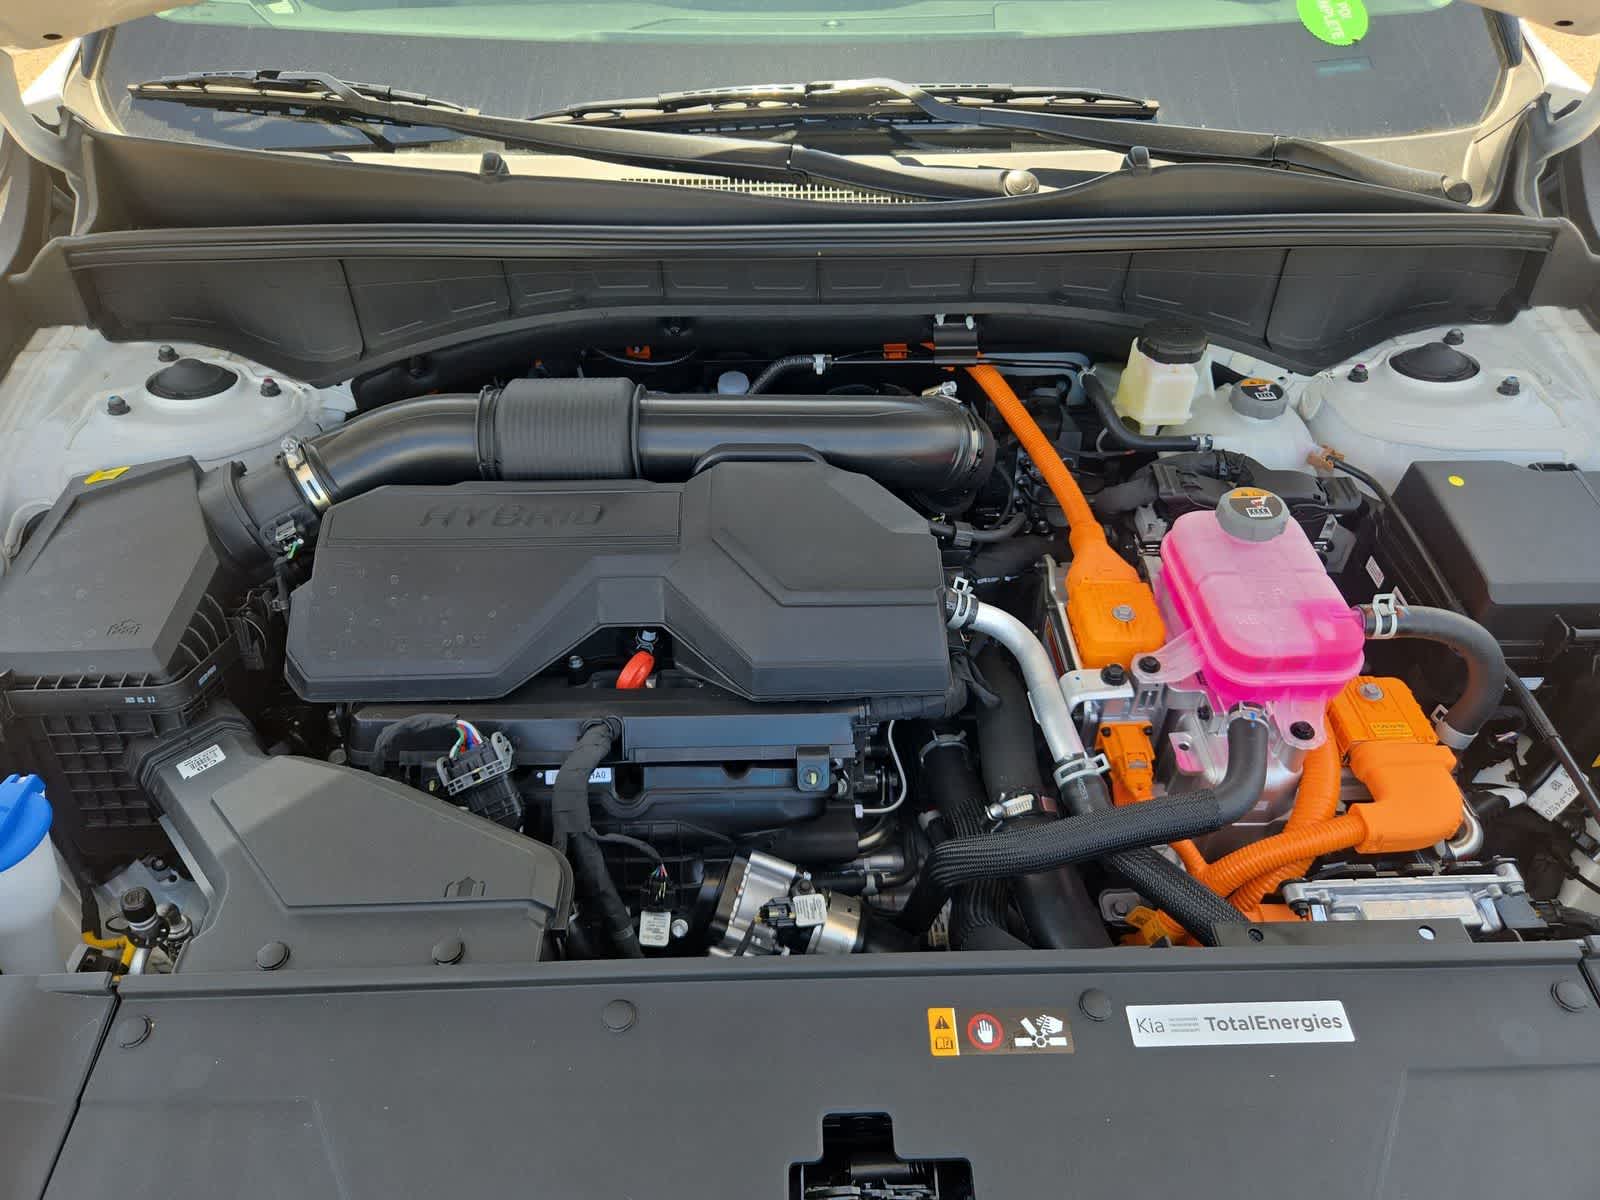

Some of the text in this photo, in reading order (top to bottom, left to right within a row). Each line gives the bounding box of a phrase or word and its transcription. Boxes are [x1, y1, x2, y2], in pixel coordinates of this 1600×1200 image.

[417, 504, 606, 528] HYBRID
[1135, 1017, 1165, 1033] Kia
[1204, 1013, 1343, 1032] TotalEnergies
